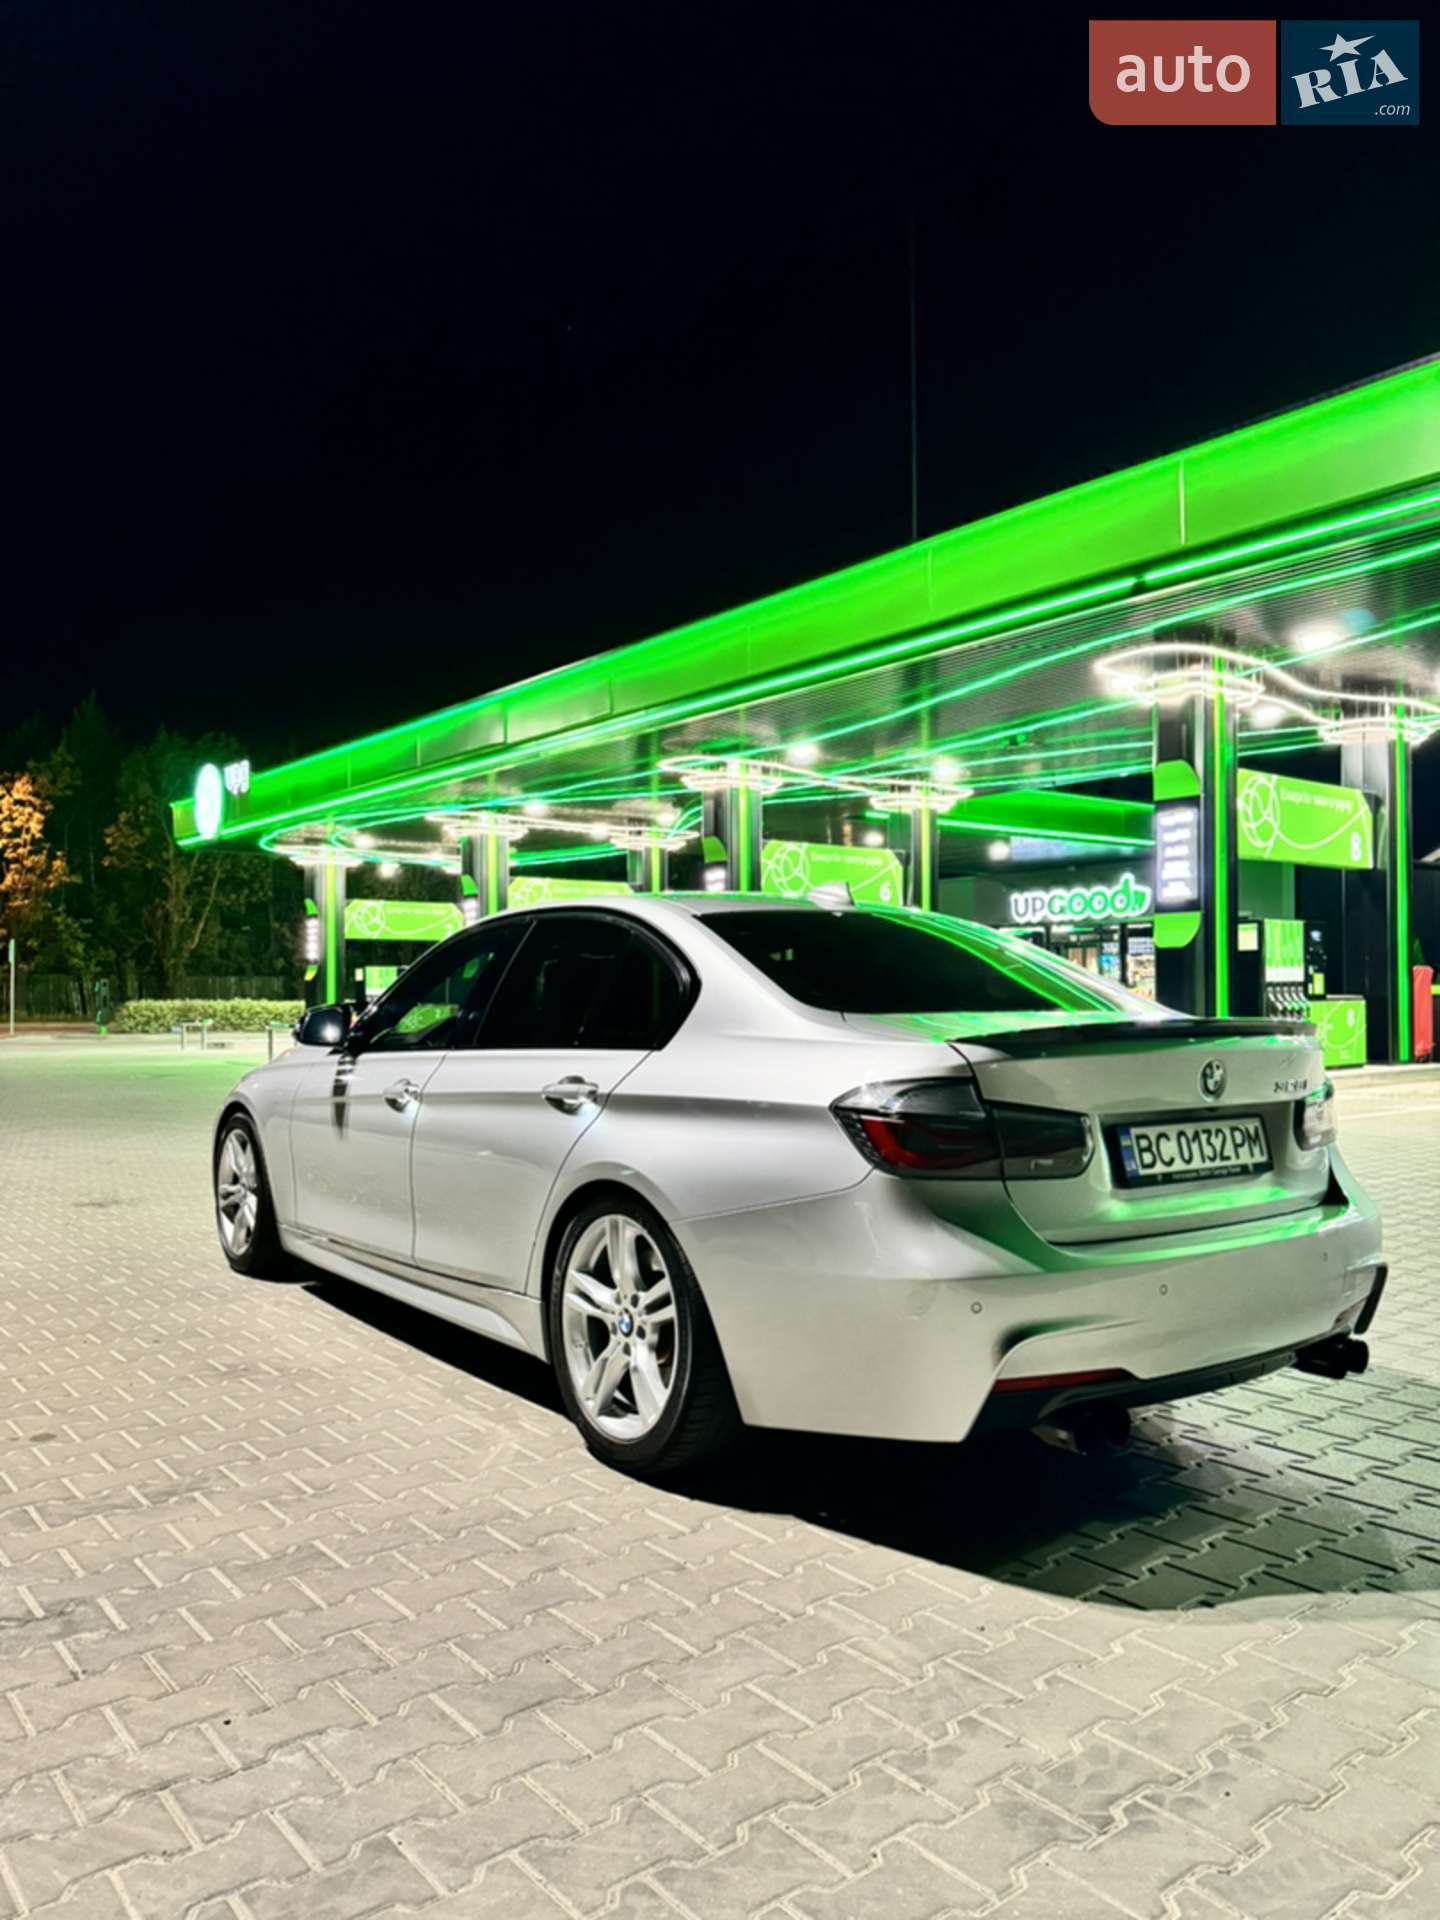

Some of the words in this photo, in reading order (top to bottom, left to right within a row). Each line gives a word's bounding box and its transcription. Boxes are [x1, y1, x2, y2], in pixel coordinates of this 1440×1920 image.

[1350, 832, 1362, 861] 8
[879, 881, 892, 902] 6
[1134, 1131, 1175, 1170] BC
[1176, 1128, 1232, 1165] 0132
[1229, 1124, 1265, 1160] PM
